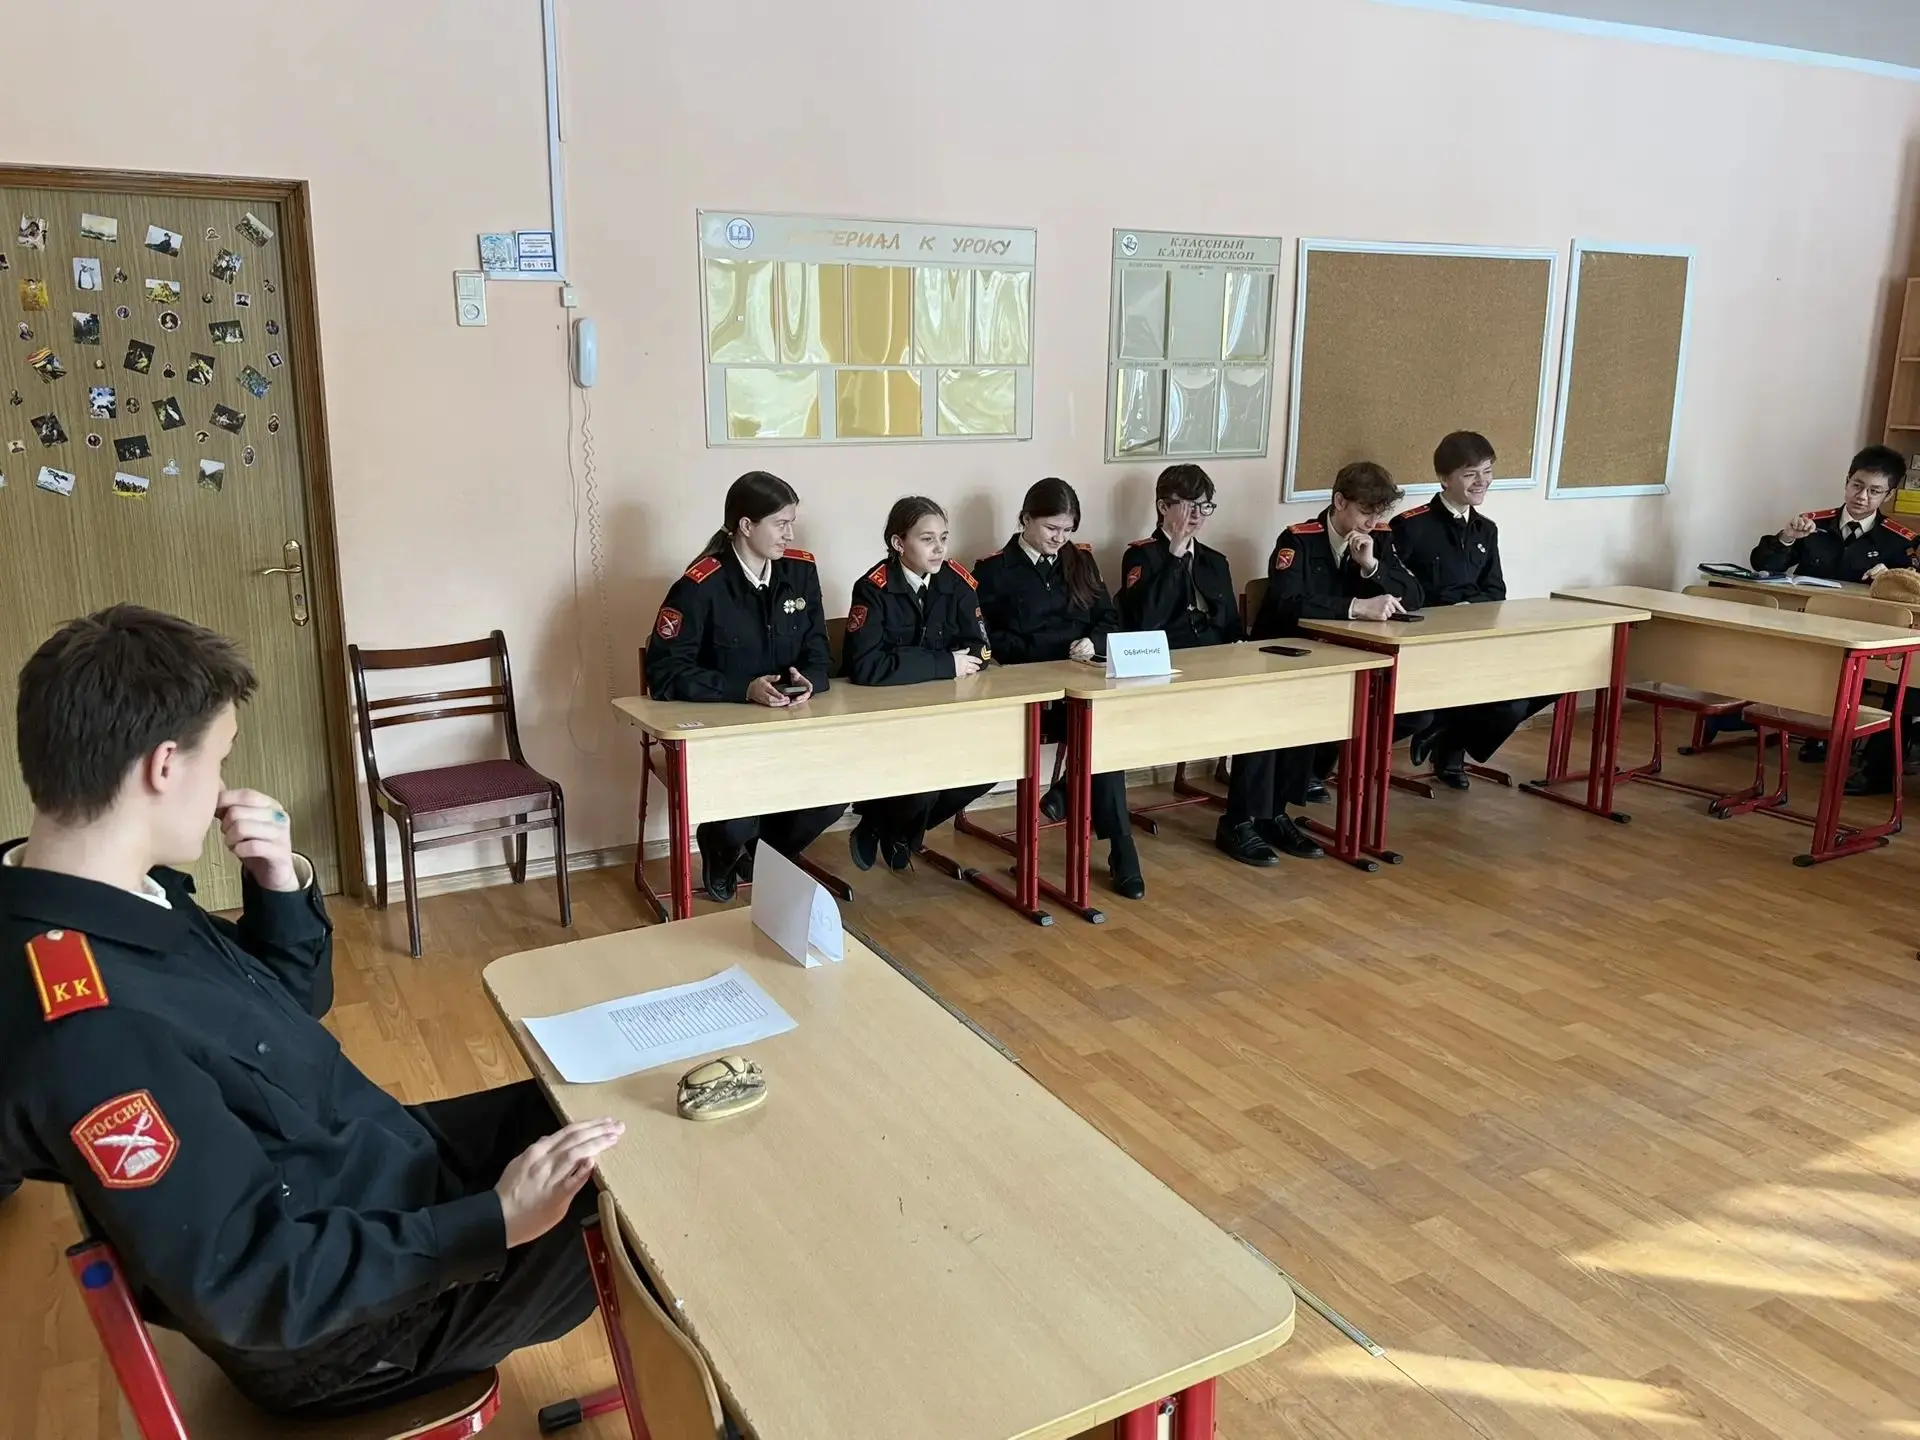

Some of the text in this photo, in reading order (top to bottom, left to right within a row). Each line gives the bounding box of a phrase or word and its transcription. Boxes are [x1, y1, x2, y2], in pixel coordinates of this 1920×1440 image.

[918, 235, 937, 252] К
[951, 236, 1012, 256] УРОКУ
[1170, 237, 1245, 249] КЛАССНЫЙ
[1156, 247, 1256, 261] КАЛЕЙДОСКОП
[84, 1096, 146, 1142] РОССИЯ
